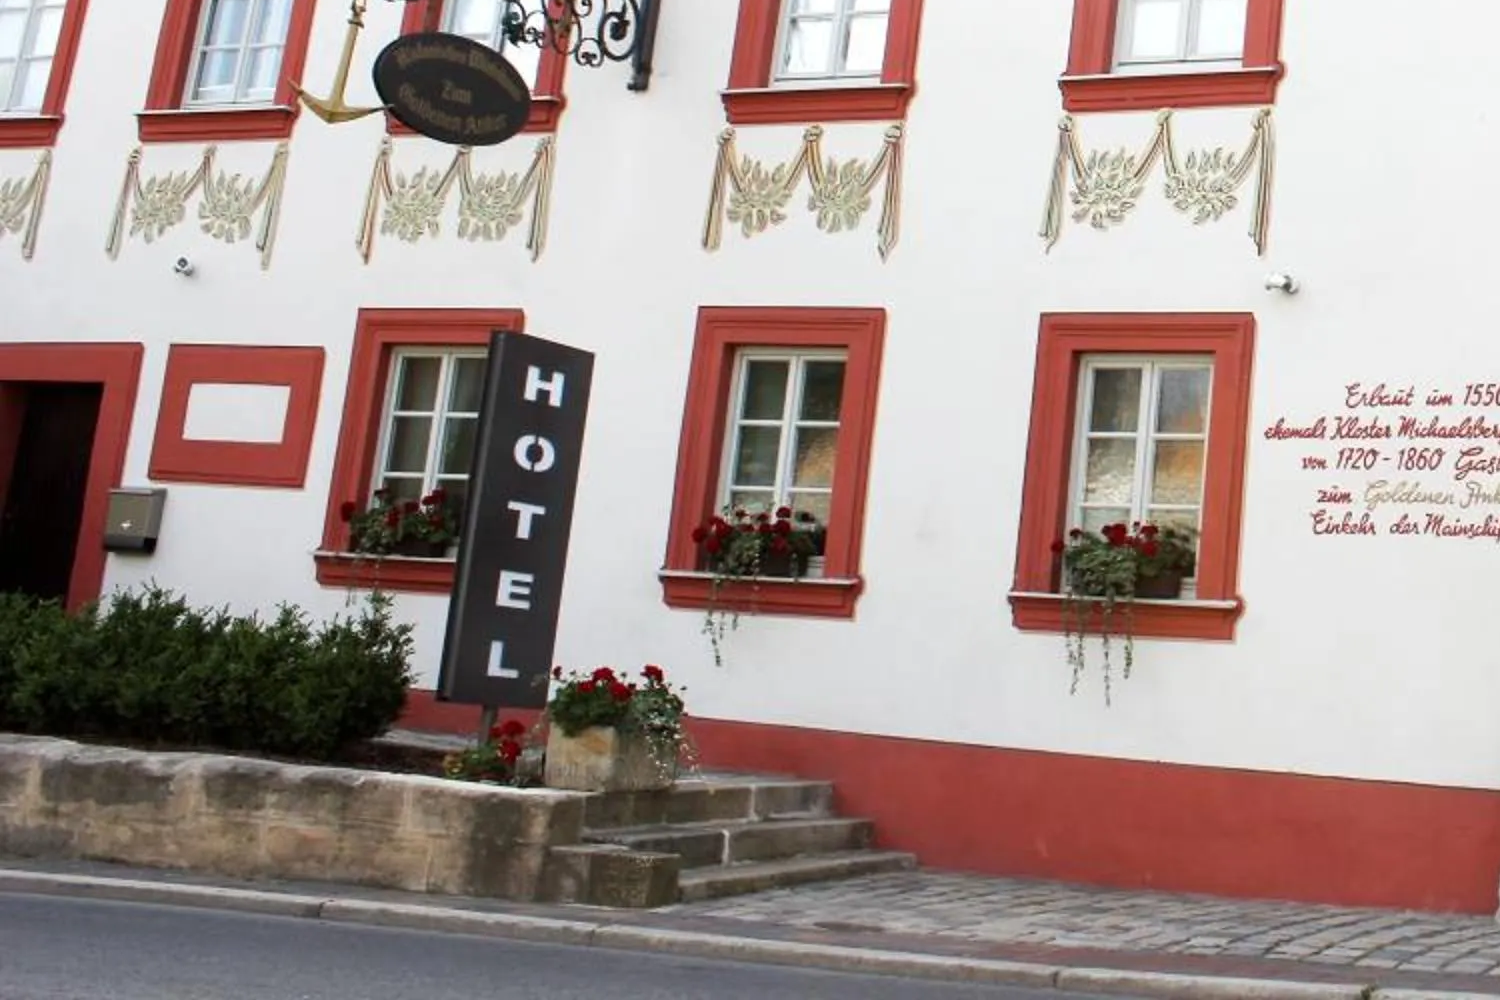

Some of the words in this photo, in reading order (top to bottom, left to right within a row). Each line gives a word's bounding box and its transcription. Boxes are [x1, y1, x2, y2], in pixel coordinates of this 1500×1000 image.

[1263, 415, 1327, 441] ehemals
[1329, 415, 1393, 441] Kloster
[1396, 447, 1447, 472] 1860
[486, 364, 566, 680] HOTEL
[1309, 508, 1377, 536] Einkehr
[1389, 512, 1421, 536] der
